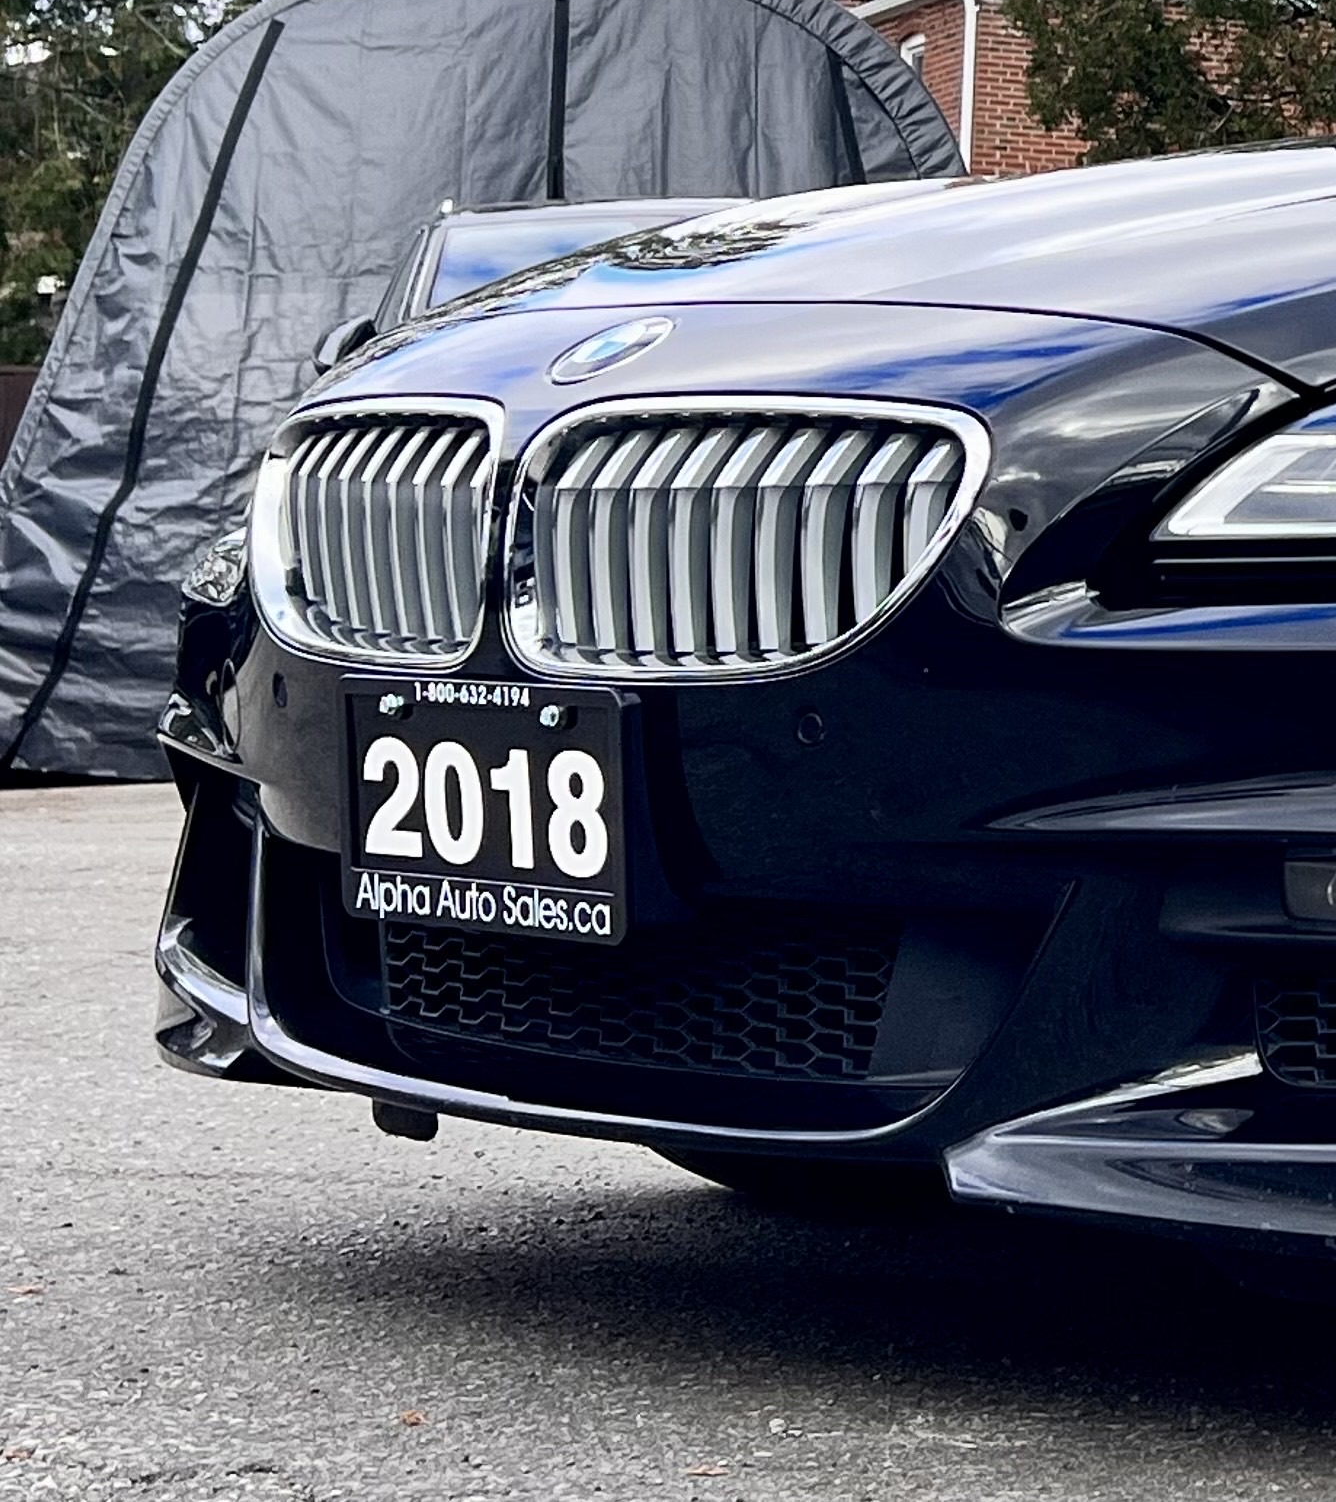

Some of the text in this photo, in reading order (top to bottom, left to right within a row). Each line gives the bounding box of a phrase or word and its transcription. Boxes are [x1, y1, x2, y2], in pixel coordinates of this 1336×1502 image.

[414, 681, 530, 707] 1-800-632-4194
[363, 736, 609, 879] 2018
[355, 872, 612, 936] Alpha Auto Sales.ca
